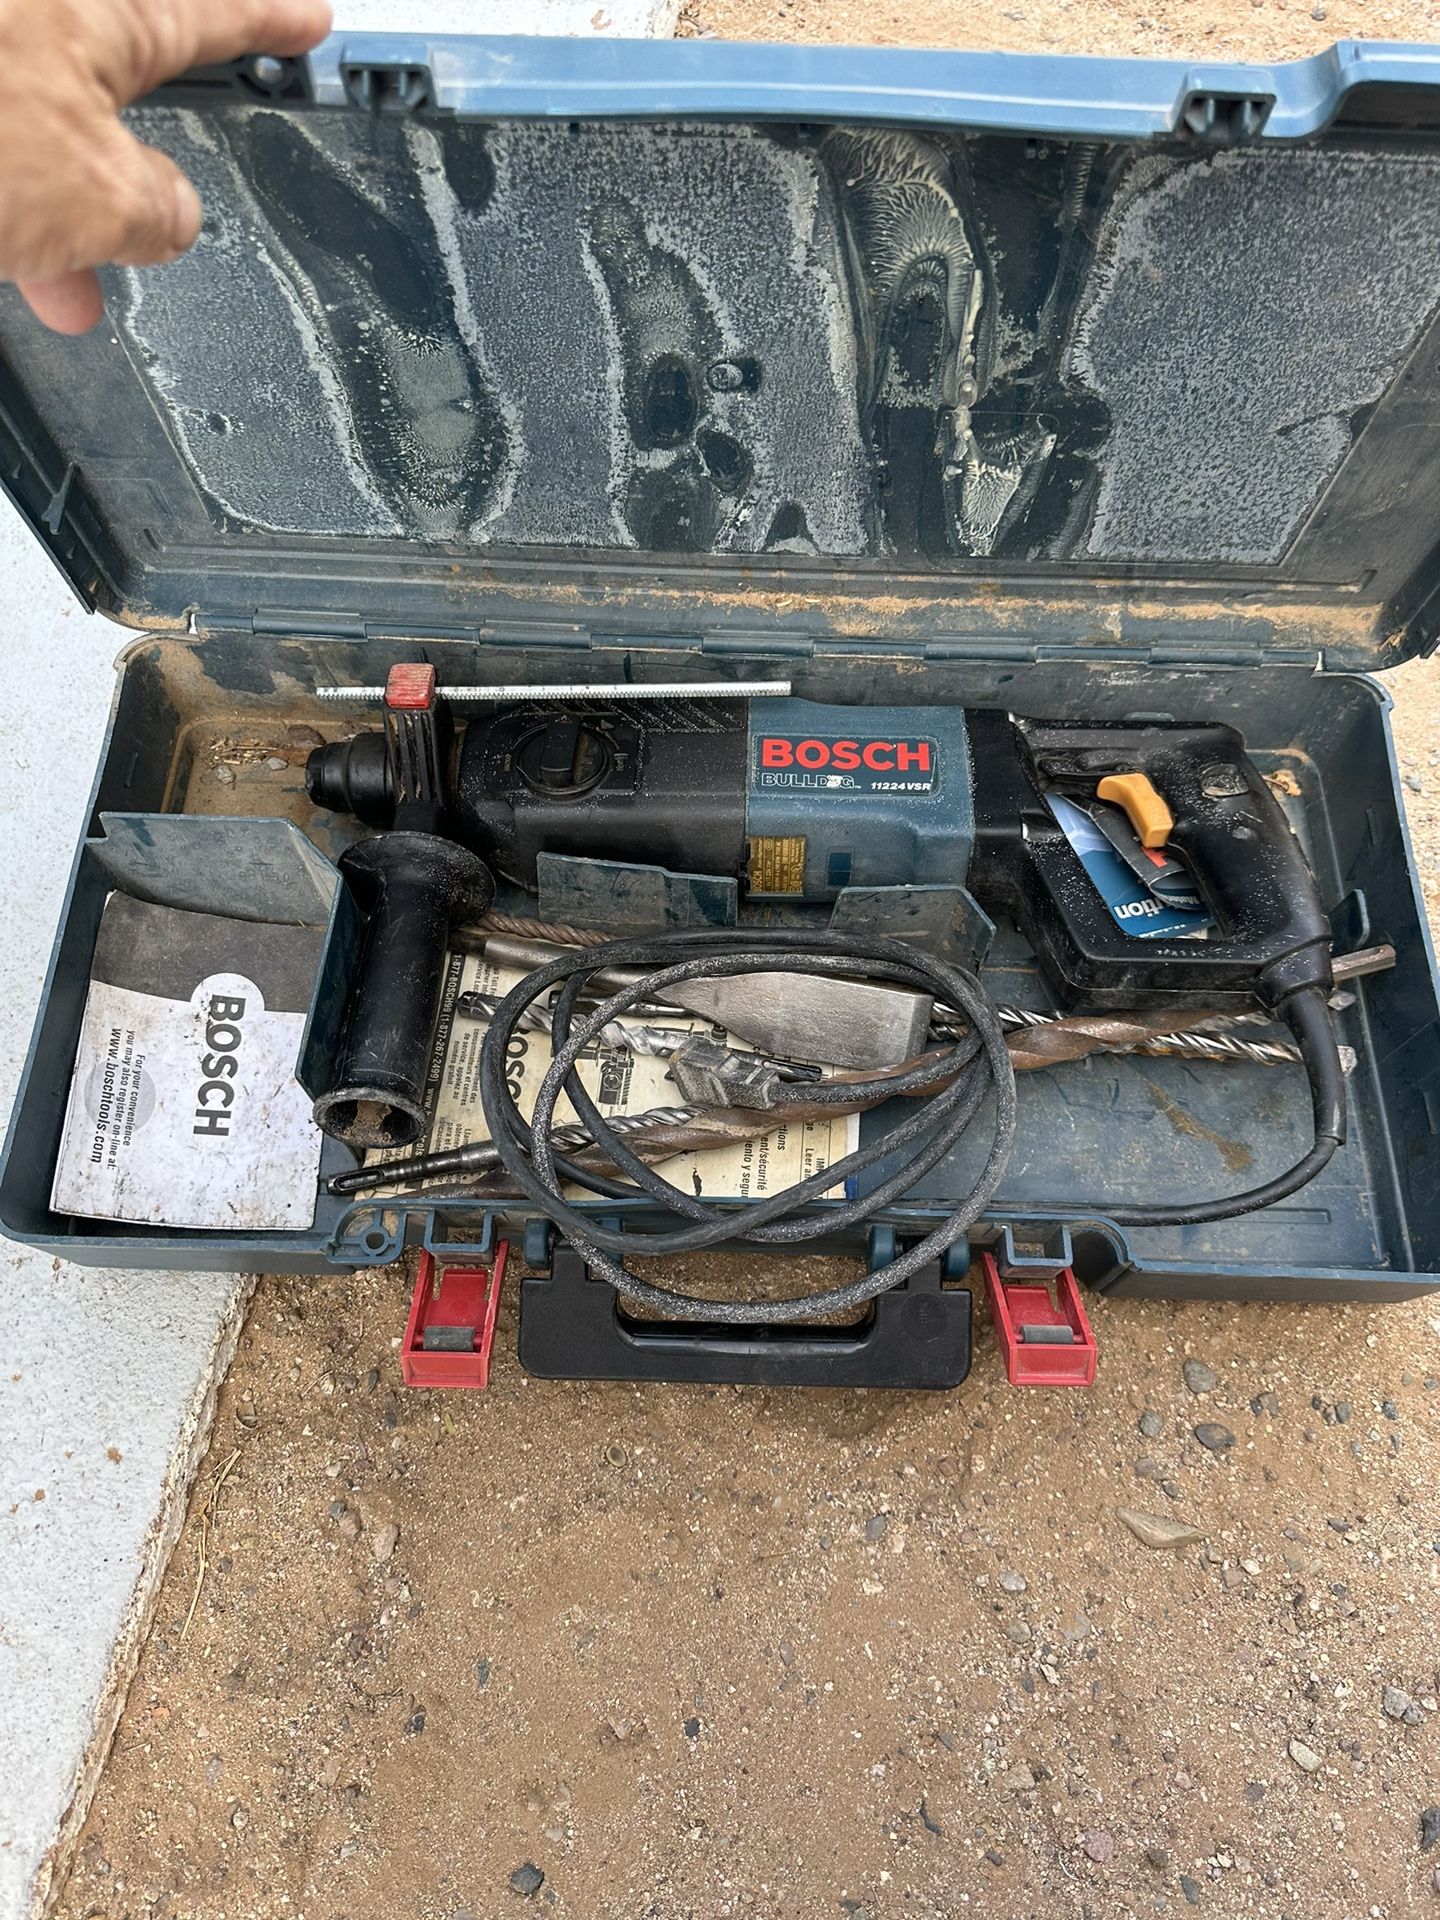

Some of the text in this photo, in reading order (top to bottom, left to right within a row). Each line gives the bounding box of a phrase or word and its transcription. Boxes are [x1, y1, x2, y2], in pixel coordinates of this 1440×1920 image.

[761, 738, 931, 771] BOSCH
[870, 781, 931, 791] 11224VSR
[443, 954, 462, 1013] 1-877-BOSCH99
[126, 1030, 135, 1046] you
[428, 1014, 451, 1082] (1-877-267-2499)
[122, 1048, 133, 1068] may
[193, 994, 246, 1136] BOSCH
[505, 1027, 530, 1107] OSC
[120, 1067, 131, 1086] also
[90, 1028, 122, 1164] www.boschtools.com
[115, 1088, 127, 1123] register
[122, 1054, 146, 1147] For your convenience
[109, 1124, 121, 1156] on-line
[444, 1138, 452, 1146] el
[445, 1122, 453, 1137] para
[804, 1147, 814, 1167] Leer
[816, 1157, 825, 1171] IM
